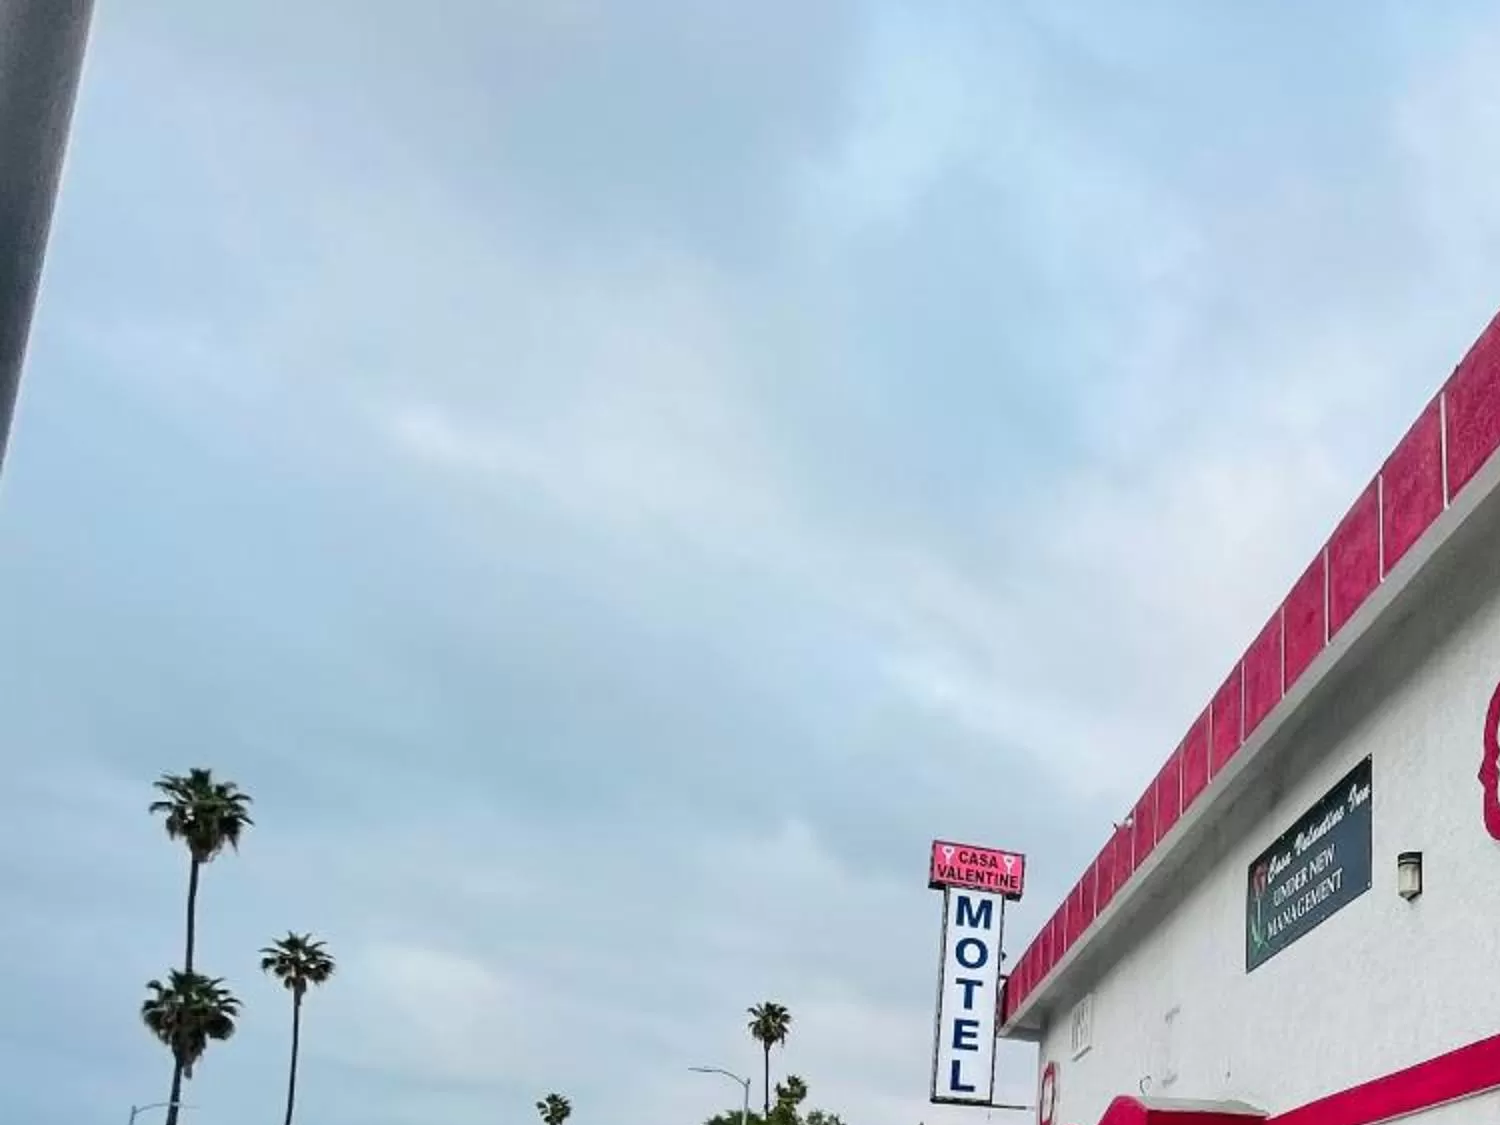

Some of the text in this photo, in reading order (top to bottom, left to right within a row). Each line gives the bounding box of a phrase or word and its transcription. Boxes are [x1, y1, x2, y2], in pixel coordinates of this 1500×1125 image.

[937, 863, 1019, 889] VALENTINE
[958, 850, 999, 869] CASA
[1273, 844, 1335, 907] UNDER NEW
[1267, 867, 1343, 940] MANAGEMENT
[950, 895, 993, 1093] MOTEL
